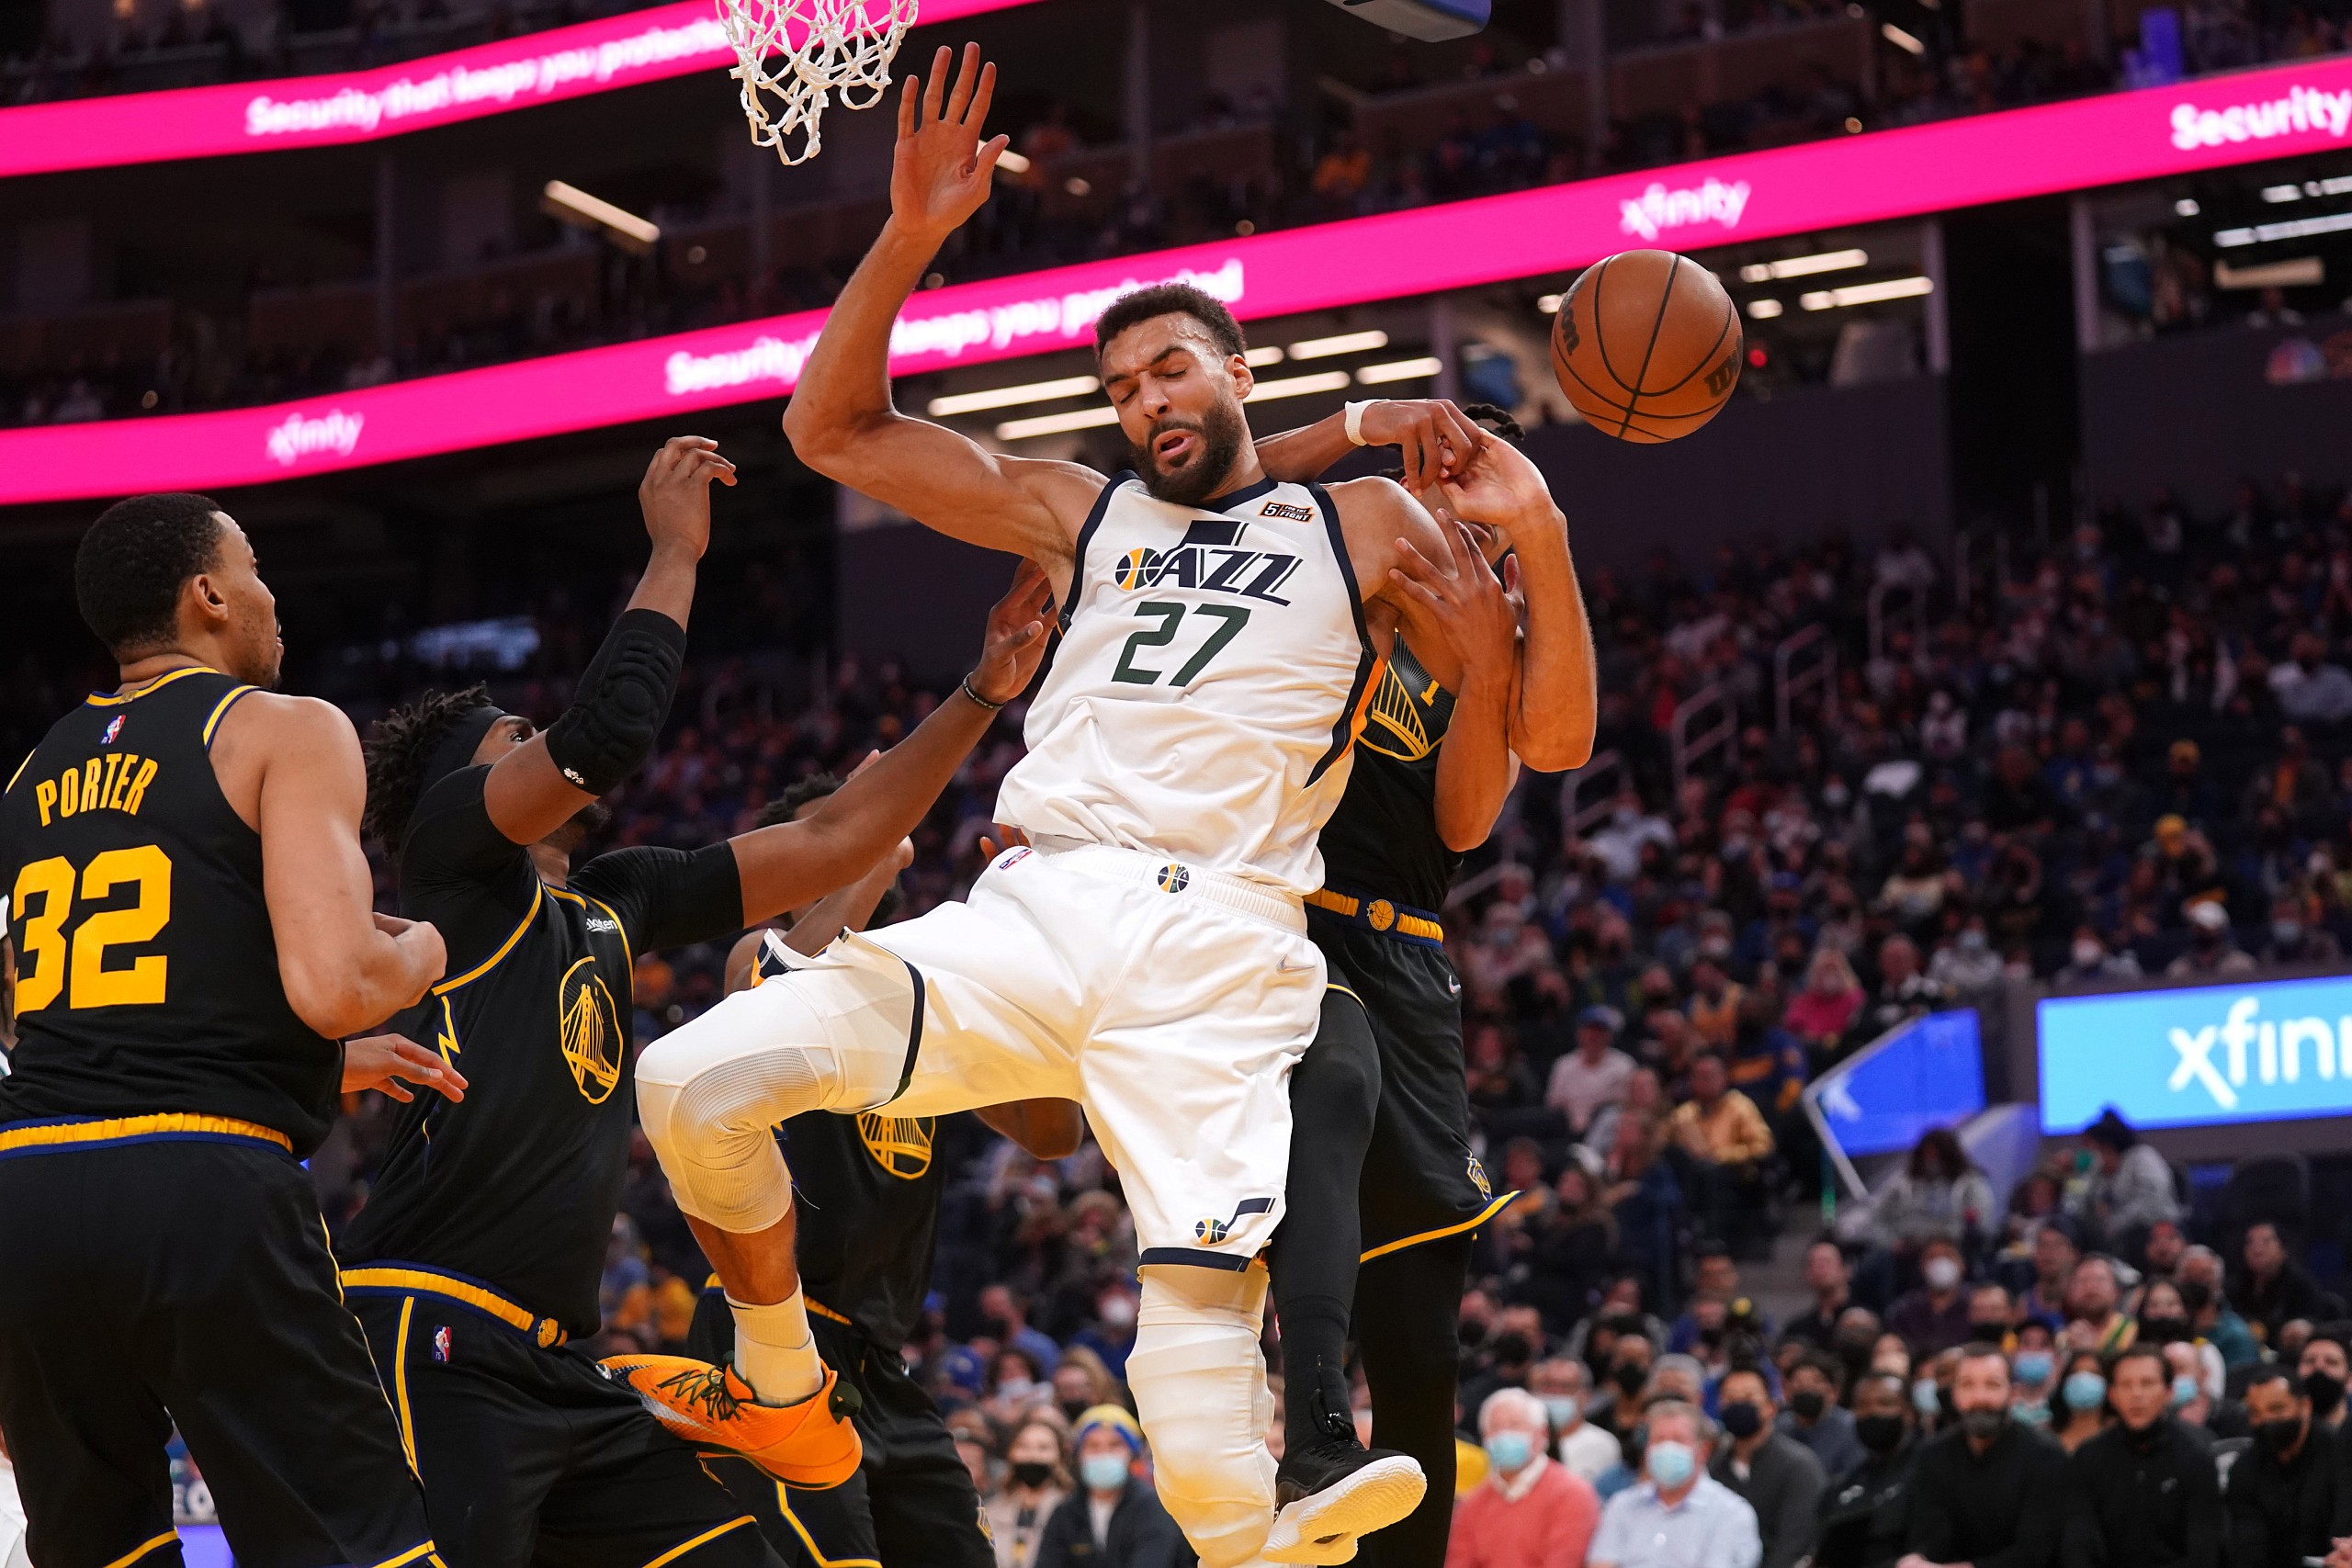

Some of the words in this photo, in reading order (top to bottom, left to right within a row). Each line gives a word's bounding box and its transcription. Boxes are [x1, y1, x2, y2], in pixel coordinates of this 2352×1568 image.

[246, 87, 380, 136] Security
[380, 77, 450, 119] that
[536, 46, 597, 95] you
[2170, 84, 2352, 152] Security
[1619, 176, 1751, 243] xfinity
[989, 297, 1063, 349] you
[265, 409, 365, 467] xfinity
[1264, 503, 1280, 516] 5
[1279, 511, 1310, 521] FIGHT
[1111, 601, 1251, 687] 27
[35, 752, 159, 828] PORTER
[13, 843, 173, 1021] 32
